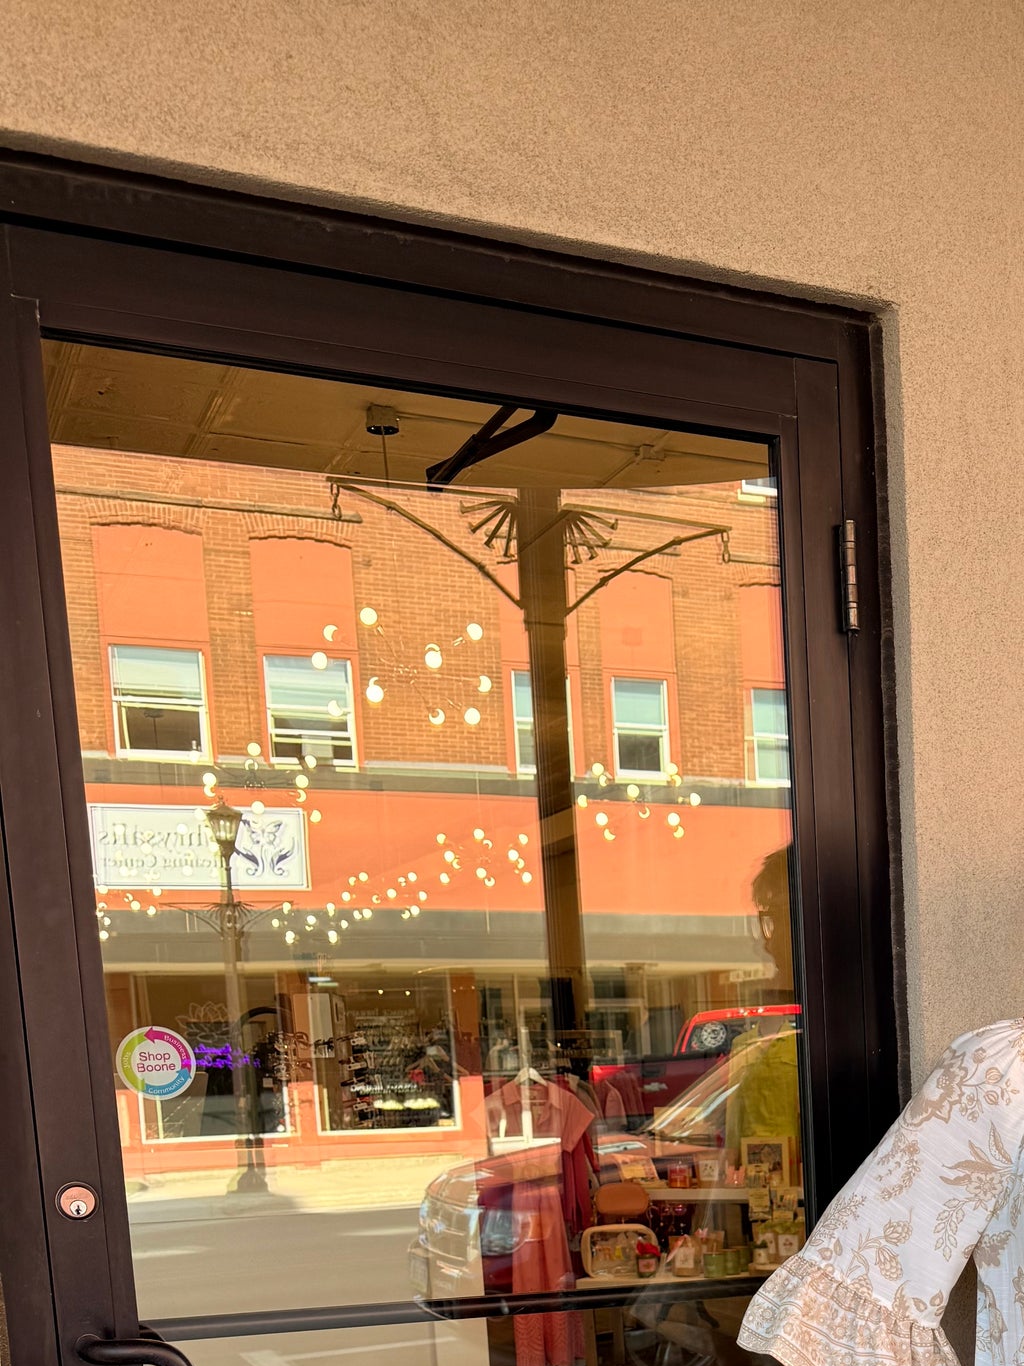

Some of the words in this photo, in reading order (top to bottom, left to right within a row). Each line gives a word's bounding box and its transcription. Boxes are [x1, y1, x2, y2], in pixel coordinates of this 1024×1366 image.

[164, 1034, 187, 1060] Business
[139, 1051, 171, 1062] Shop
[137, 1063, 176, 1073] Boone
[148, 1077, 185, 1095] Community
